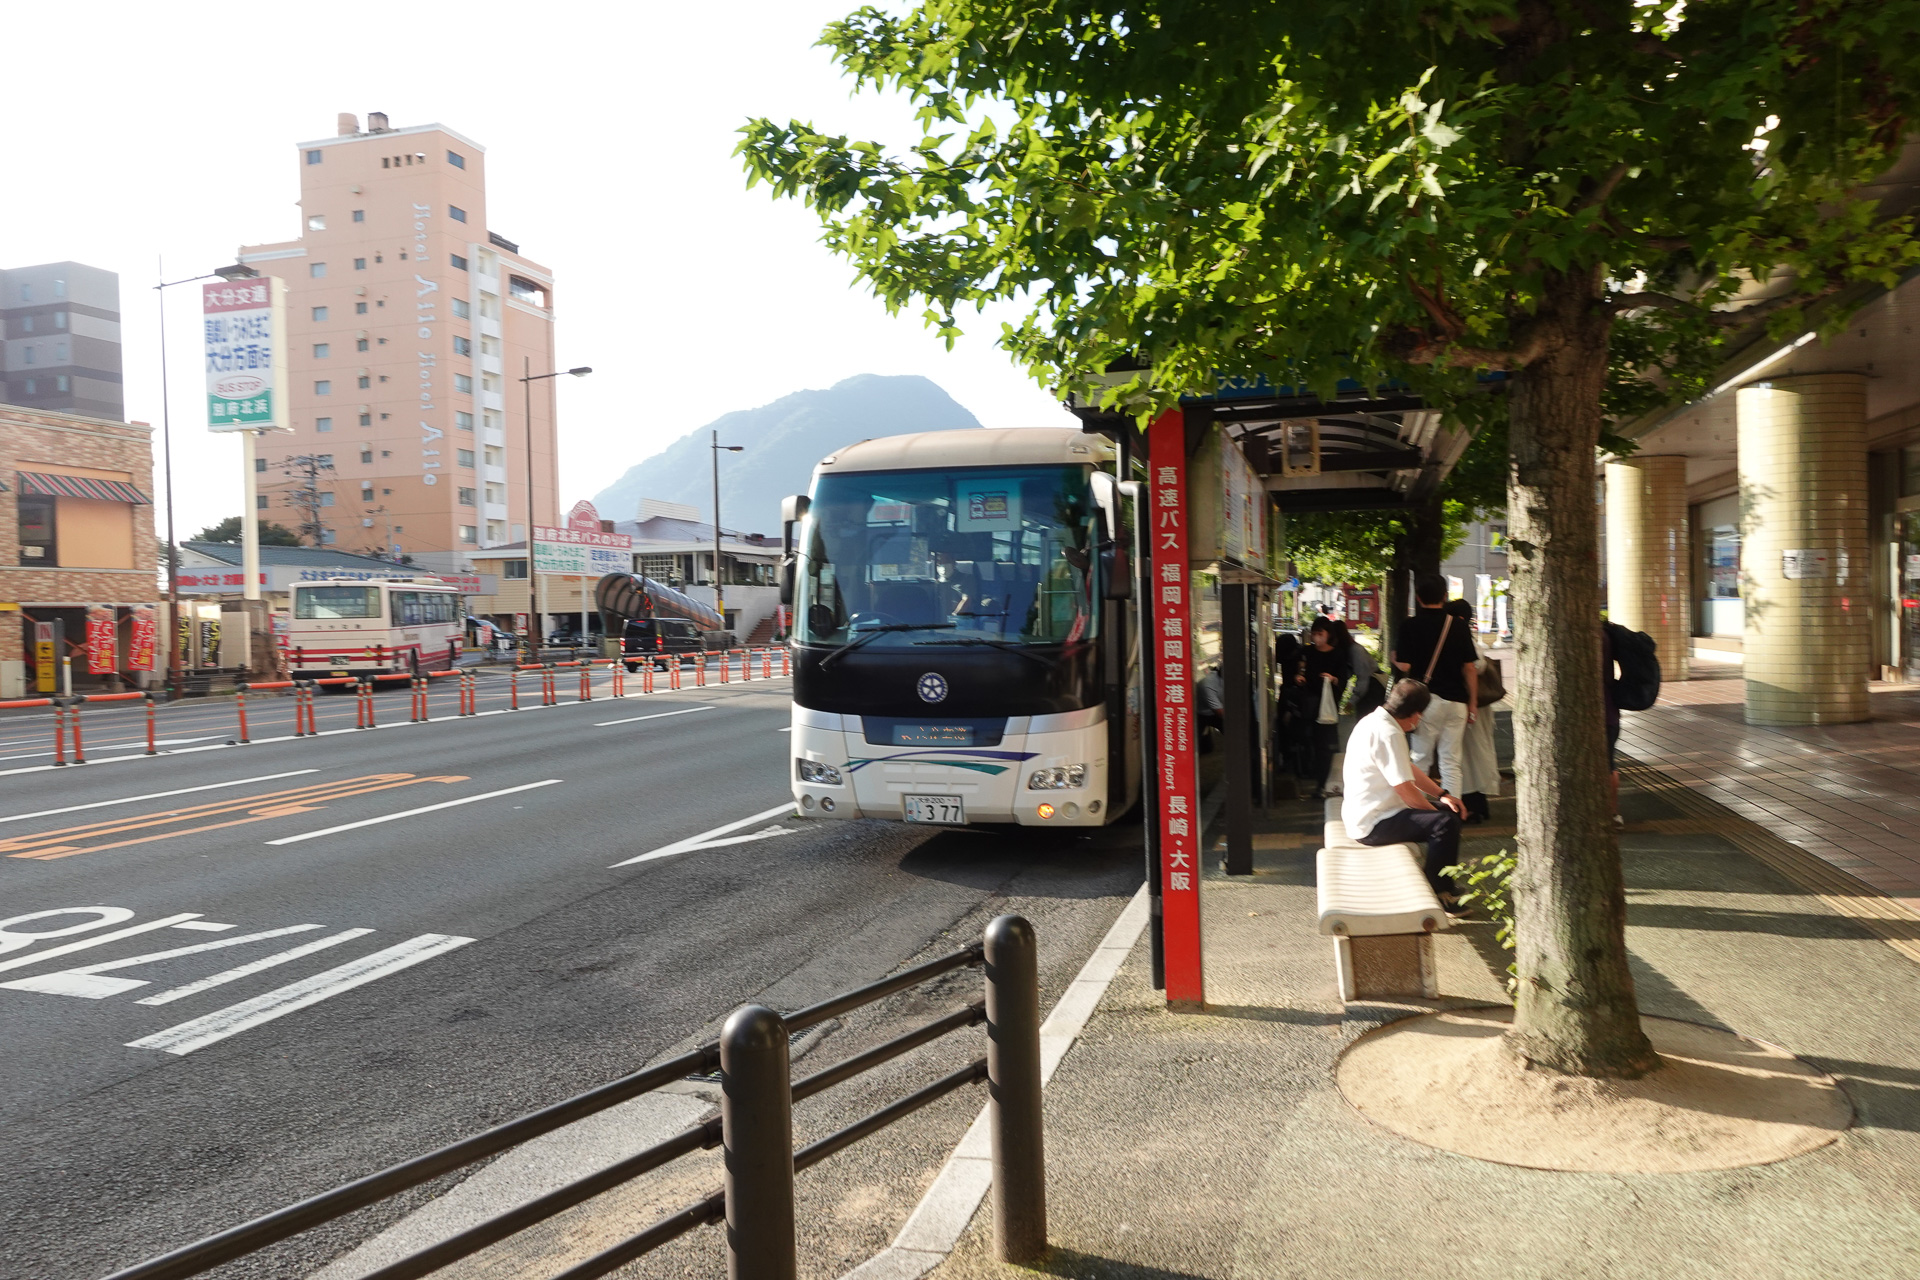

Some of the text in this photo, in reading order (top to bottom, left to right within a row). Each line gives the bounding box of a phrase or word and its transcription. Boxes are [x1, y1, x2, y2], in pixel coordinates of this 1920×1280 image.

[412, 202, 431, 262] Hotel
[205, 285, 268, 307] 大分交通
[216, 380, 262, 393] BUS STOP
[417, 351, 436, 410] Hotel
[1157, 466, 1180, 550] 高速バス
[1160, 563, 1185, 703] 福岡・福岡空港
[1163, 706, 1176, 790] Fukuoka Airport
[1176, 706, 1188, 751] Fukuoka
[1167, 795, 1191, 891] 長崎・大阪
